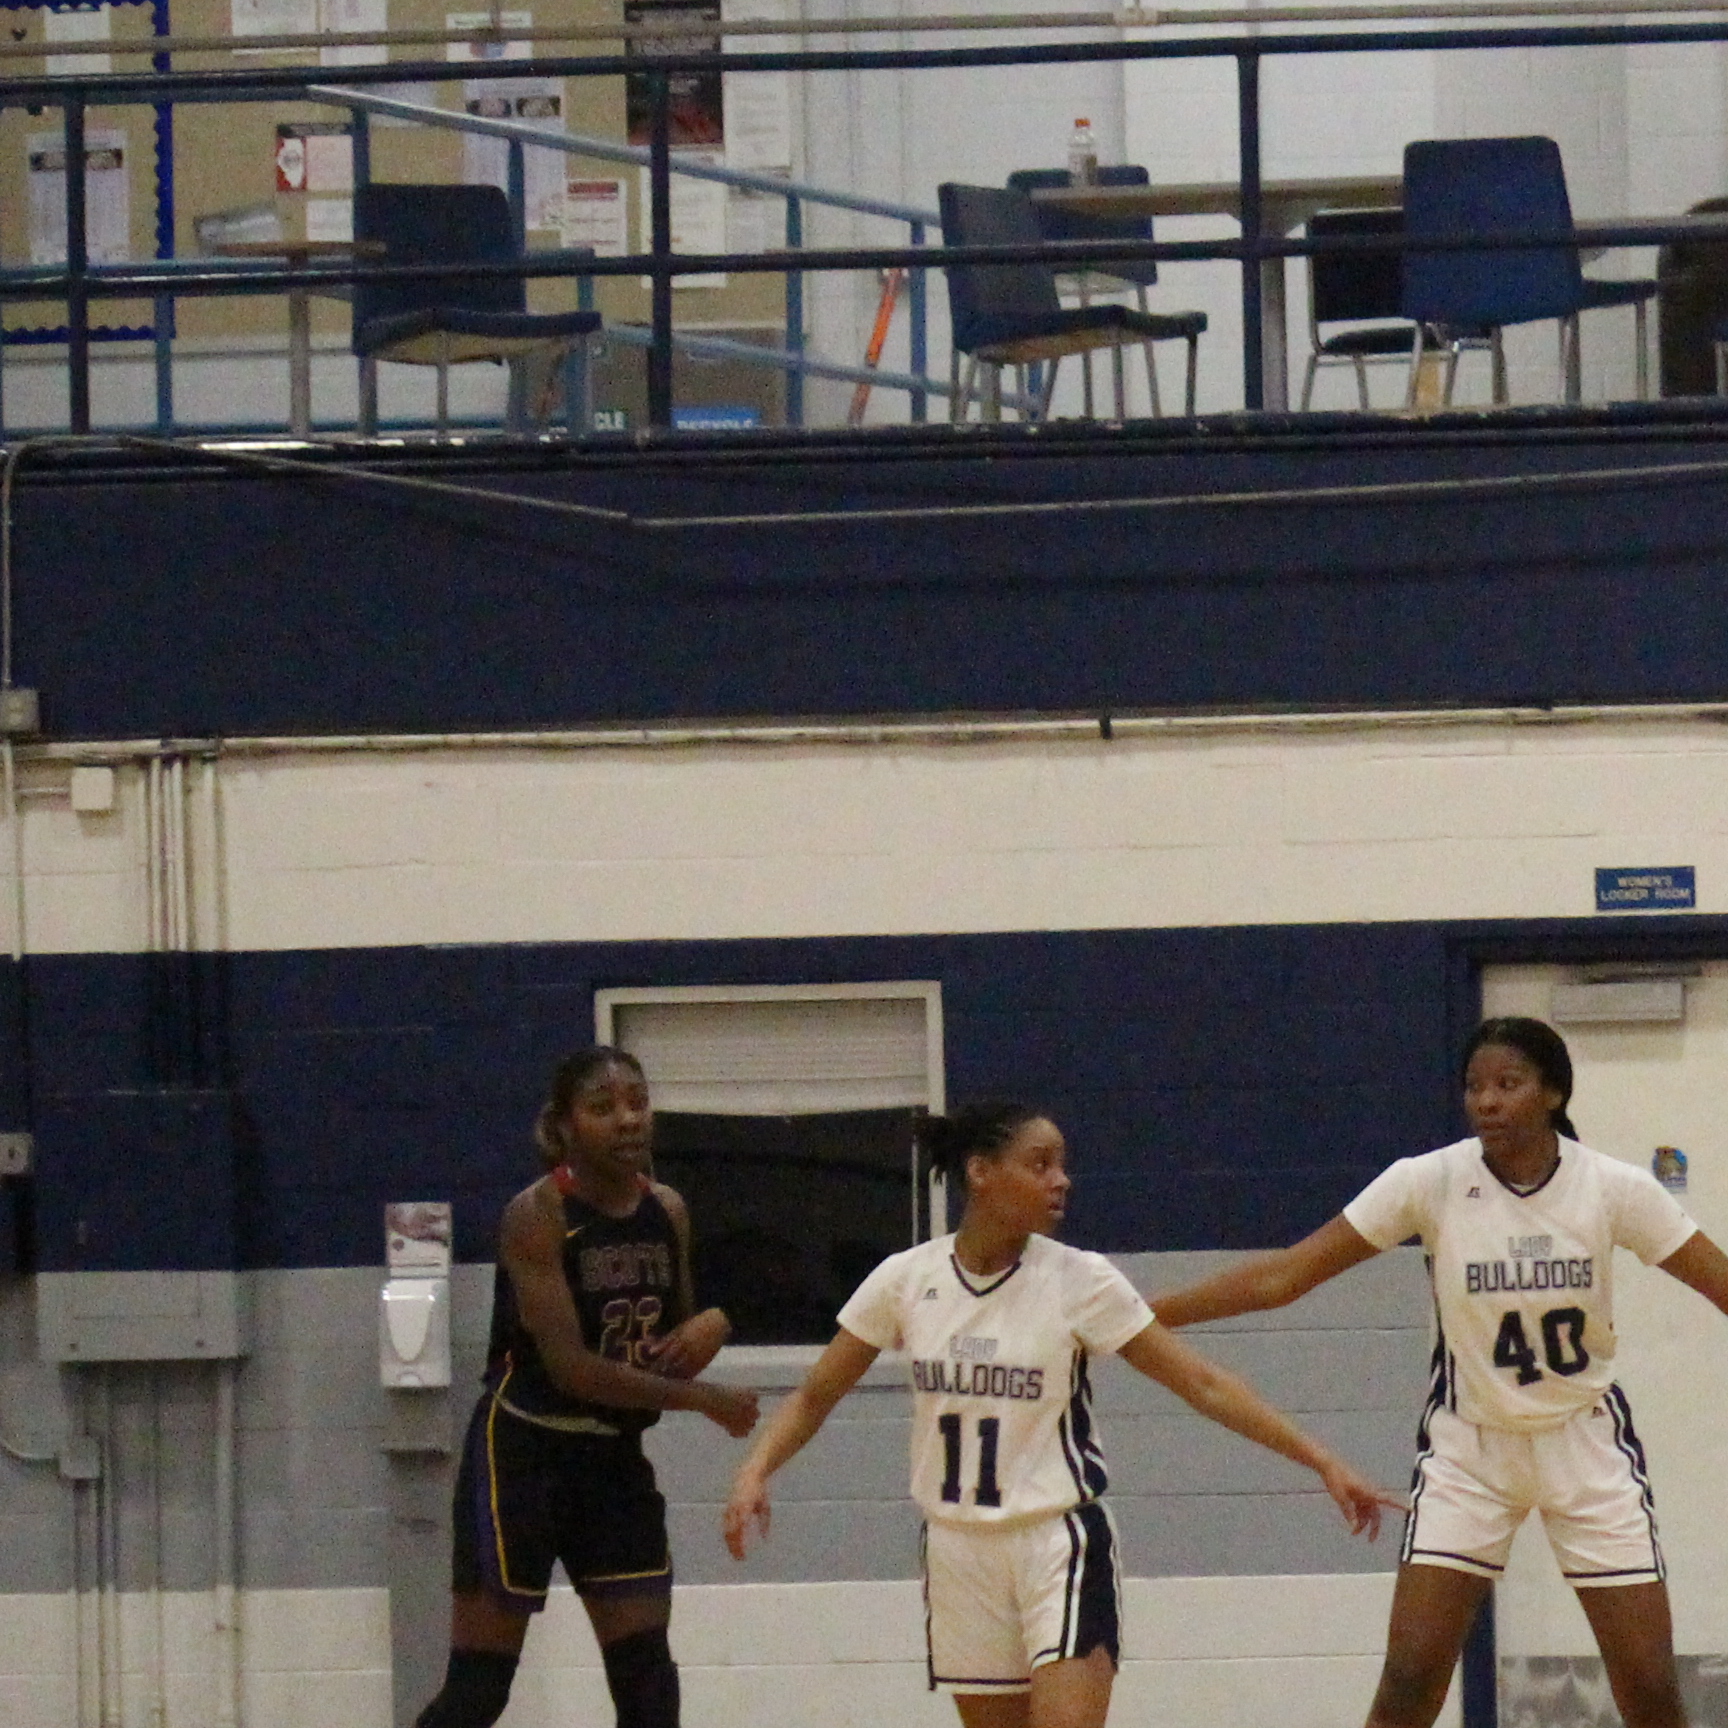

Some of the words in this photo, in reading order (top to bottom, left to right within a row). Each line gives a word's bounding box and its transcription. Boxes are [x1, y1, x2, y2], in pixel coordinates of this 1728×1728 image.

[1466, 1257, 1593, 1294] BULLDOGS
[1493, 1306, 1590, 1387] 40
[913, 1359, 1044, 1401] BULLDOGS
[938, 1413, 1003, 1508] 11
